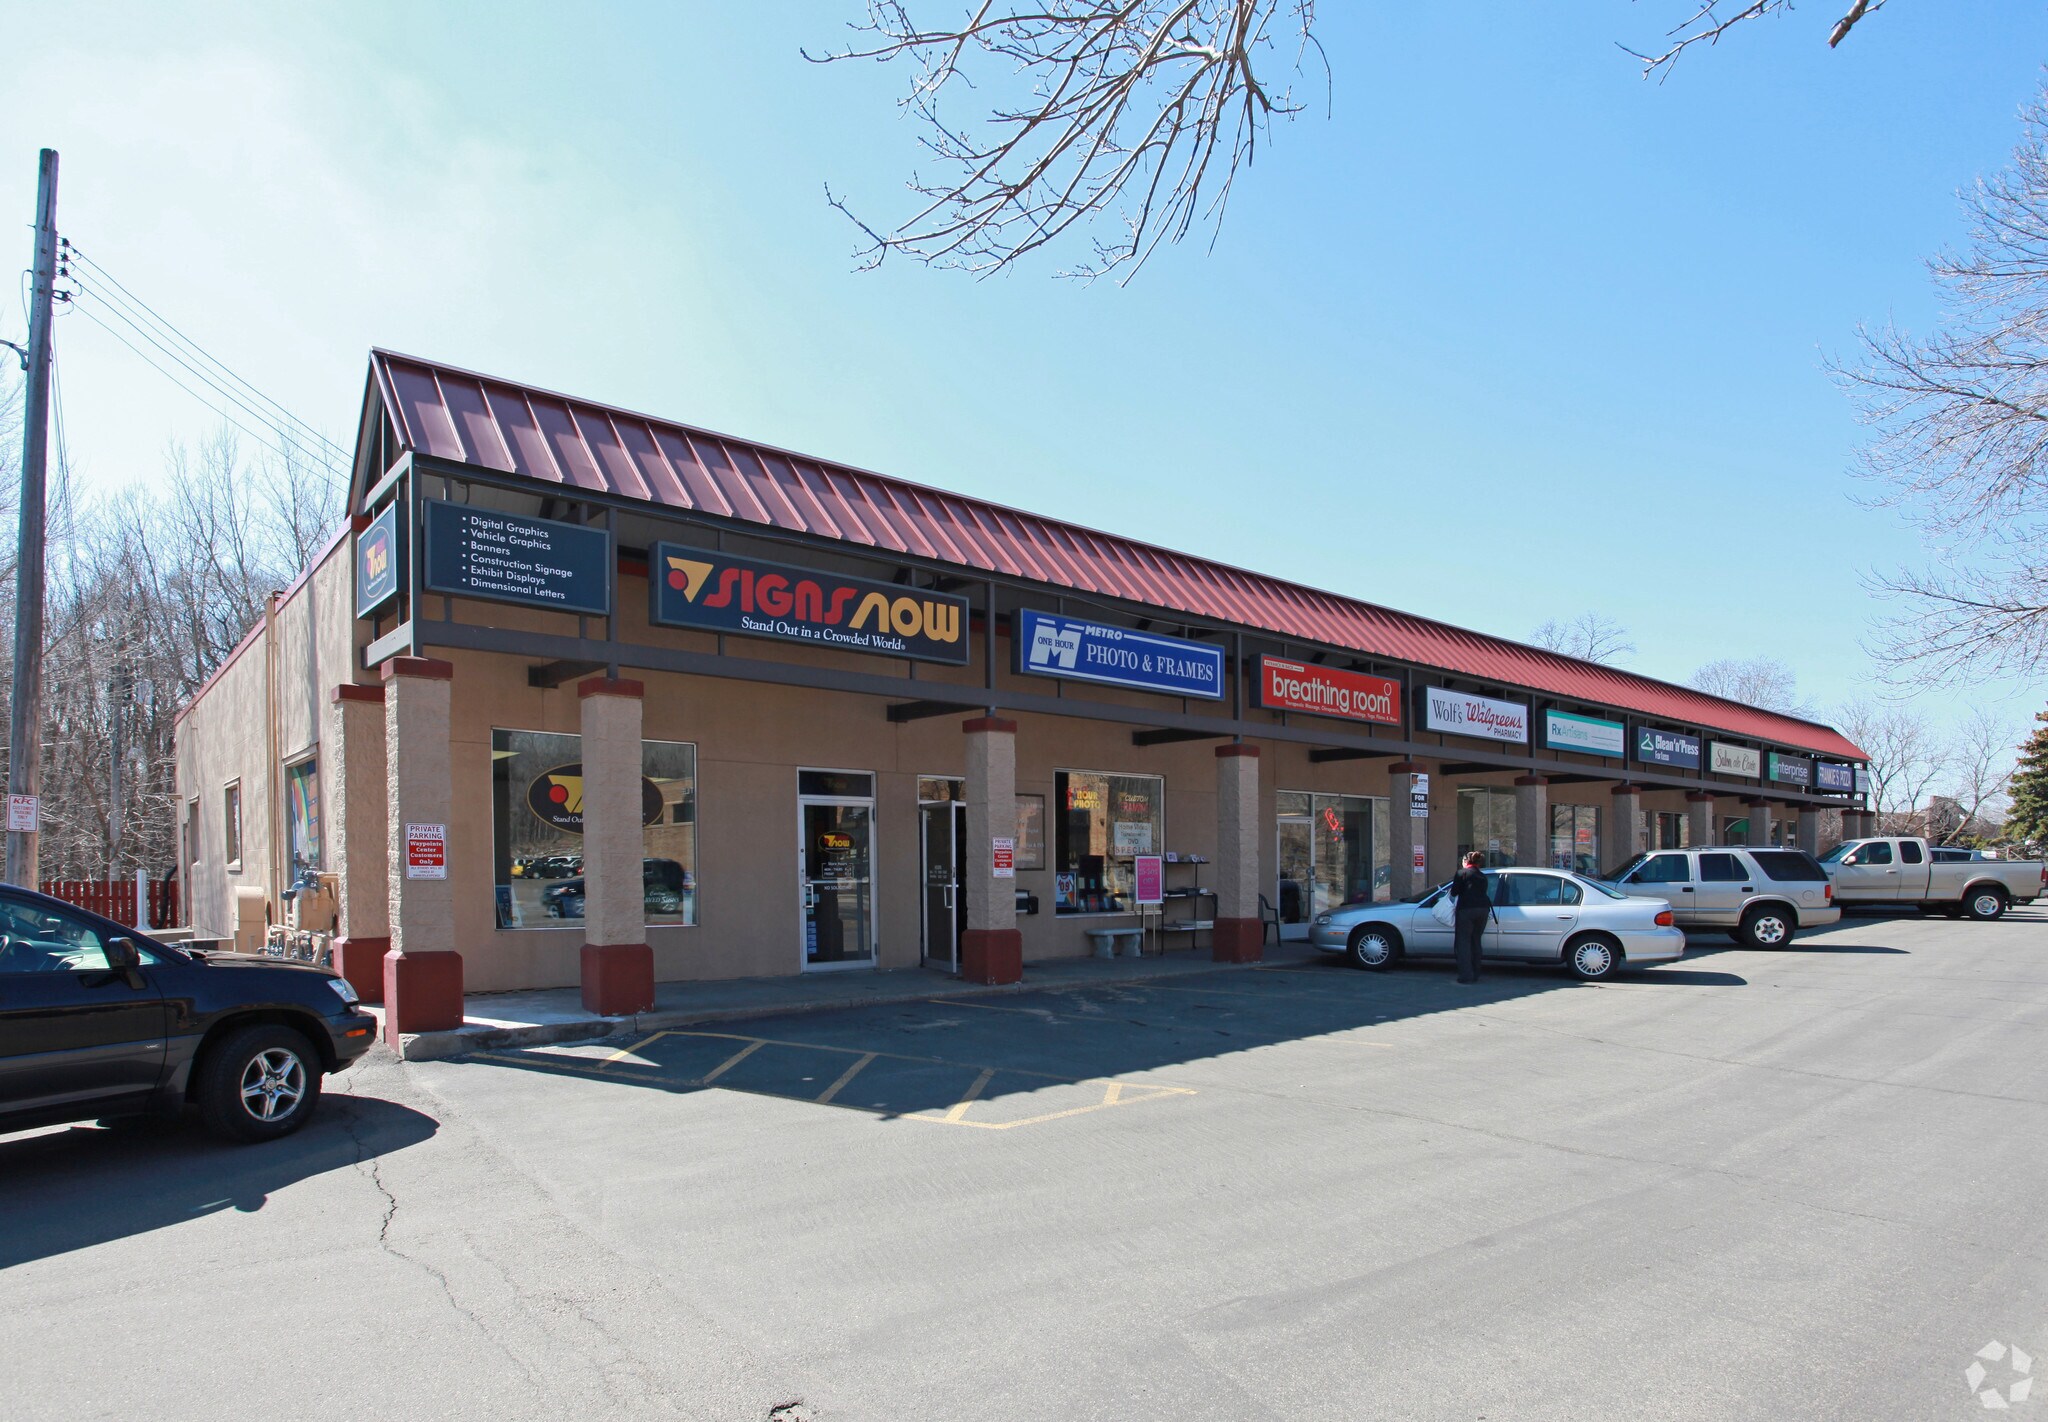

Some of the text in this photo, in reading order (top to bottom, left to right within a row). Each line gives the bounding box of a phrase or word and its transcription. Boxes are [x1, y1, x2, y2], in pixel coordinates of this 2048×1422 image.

[470, 516, 549, 539] Digital Graphics
[470, 528, 551, 551] Vehicle Graphics
[470, 541, 510, 556] Banners
[470, 553, 572, 579] Construction Signage
[470, 566, 546, 585] Exhibit Displays
[470, 578, 566, 600] Dimensional Letters
[742, 616, 774, 632] Stand
[776, 622, 798, 636] Out
[801, 626, 812, 637] in
[814, 630, 820, 639] a
[823, 628, 869, 646] Crowded
[1085, 625, 1122, 640] METRO
[1038, 636, 1074, 650] ONE HOUR
[1086, 644, 1214, 682] PHOTO & FRAMES
[1272, 670, 1391, 714] breathing room
[1432, 699, 1522, 731] Wolf's Walgreens
[1494, 728, 1522, 740] PHARMACY
[1770, 762, 1808, 779] enterprise
[1840, 770, 1851, 787] PIZZA
[13, 796, 34, 805] KFC
[1074, 800, 1100, 808] PHOTO
[1076, 790, 1098, 800] HOUR
